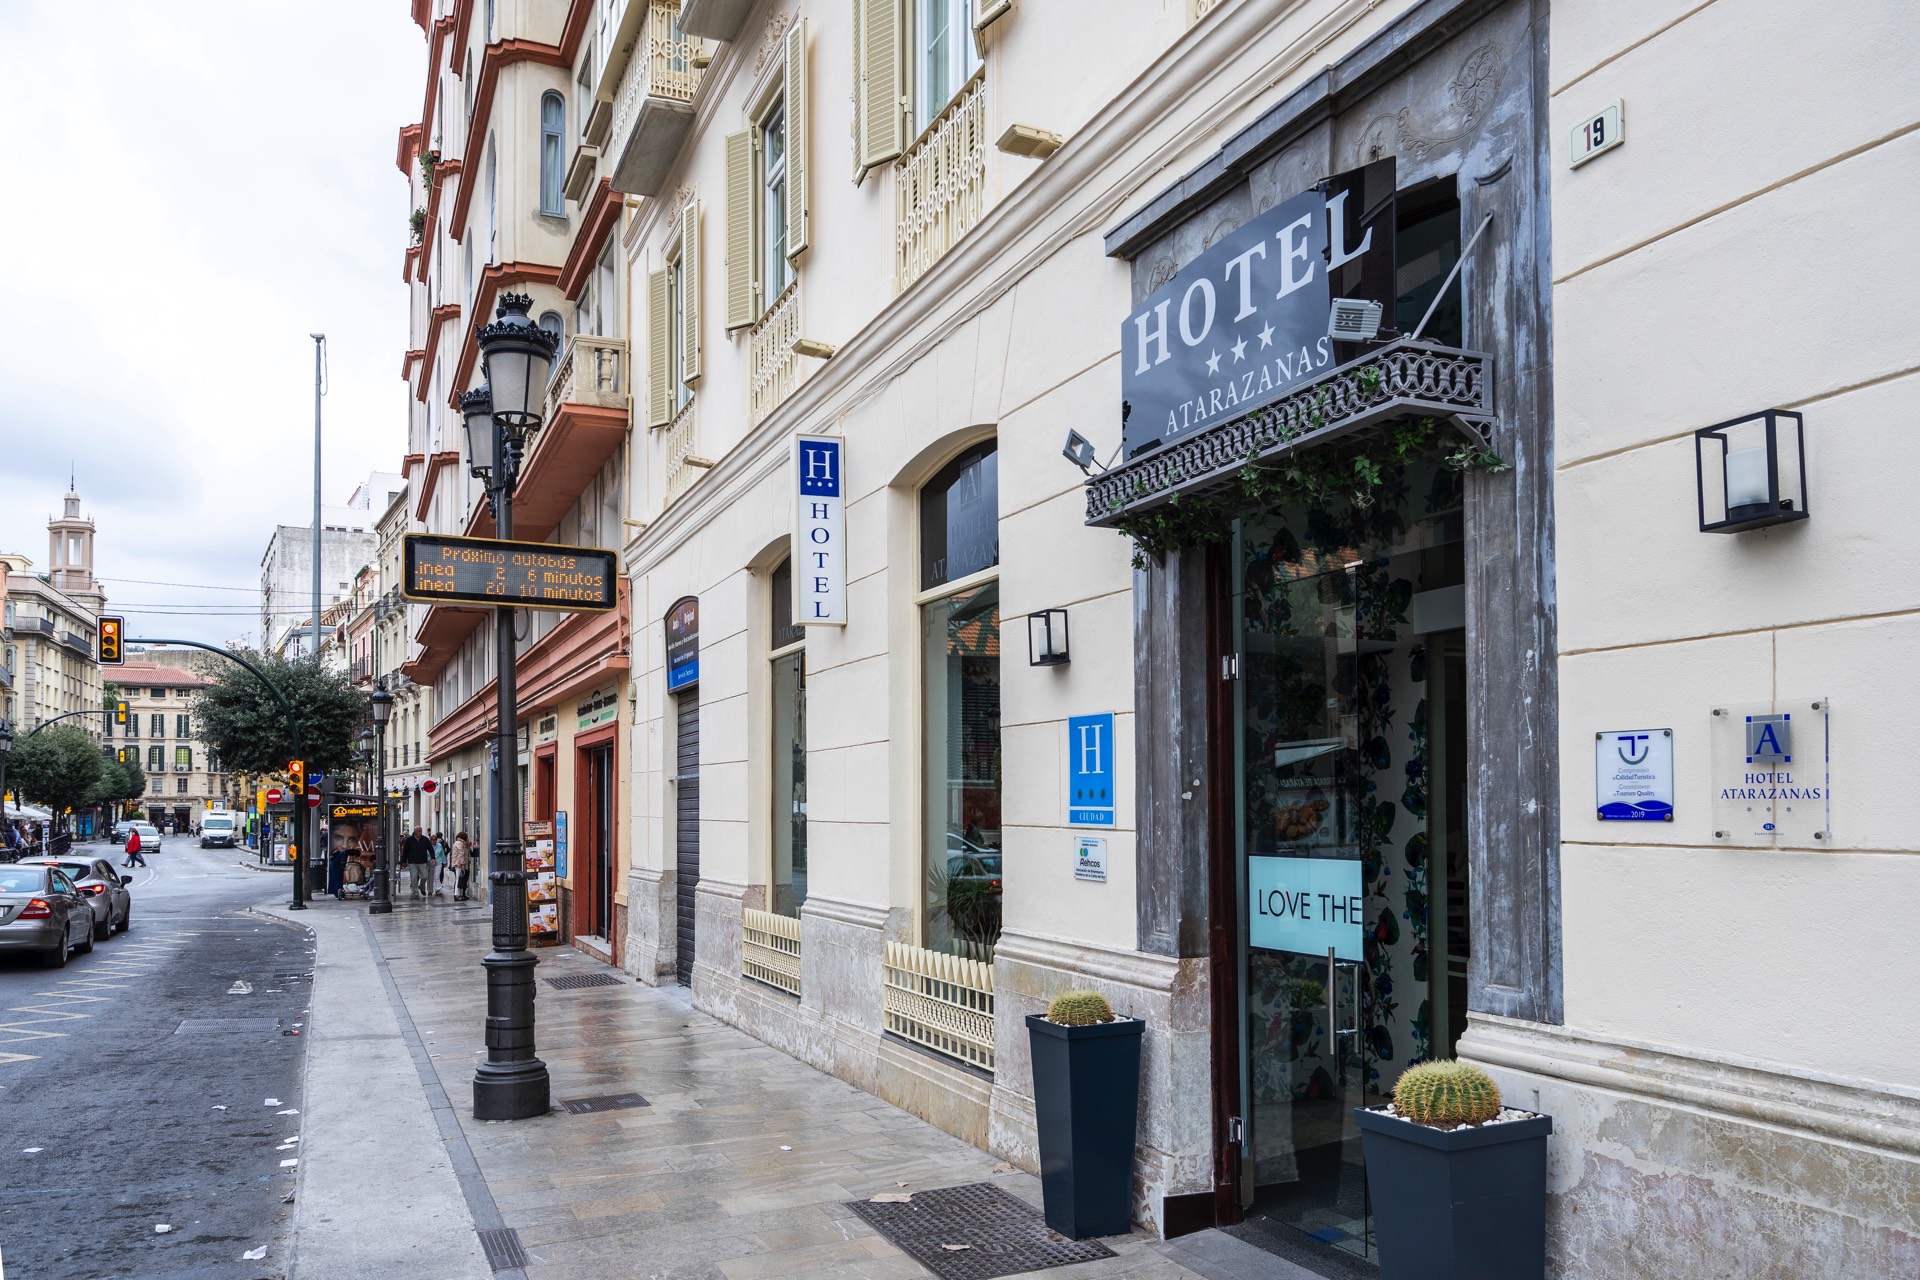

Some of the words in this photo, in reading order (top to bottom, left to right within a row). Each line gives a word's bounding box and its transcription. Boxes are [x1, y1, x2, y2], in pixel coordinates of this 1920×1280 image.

[1583, 116, 1605, 152] 19
[1134, 188, 1373, 377] HOTEL
[1165, 335, 1331, 437] ATARAZANAS
[805, 449, 834, 480] H
[414, 561, 454, 577] inea
[496, 566, 505, 580] 2
[528, 569, 537, 582] 6
[543, 570, 602, 586] minutos
[442, 547, 505, 564] Próximo
[512, 553, 576, 569] autobús
[810, 502, 831, 618] HOTEL
[414, 577, 454, 592] inea
[486, 581, 505, 595] 20
[520, 584, 537, 597] 10
[543, 586, 602, 602] minutos
[1077, 724, 1105, 775] H
[1754, 723, 1783, 755] A
[1745, 772, 1794, 784] HOTEL
[1720, 788, 1821, 800] ATARAZANAS
[1079, 812, 1105, 821] CIUDAD
[1079, 858, 1101, 868] Aehcos
[1259, 889, 1311, 919] LOVE
[1318, 893, 1363, 925] THE
